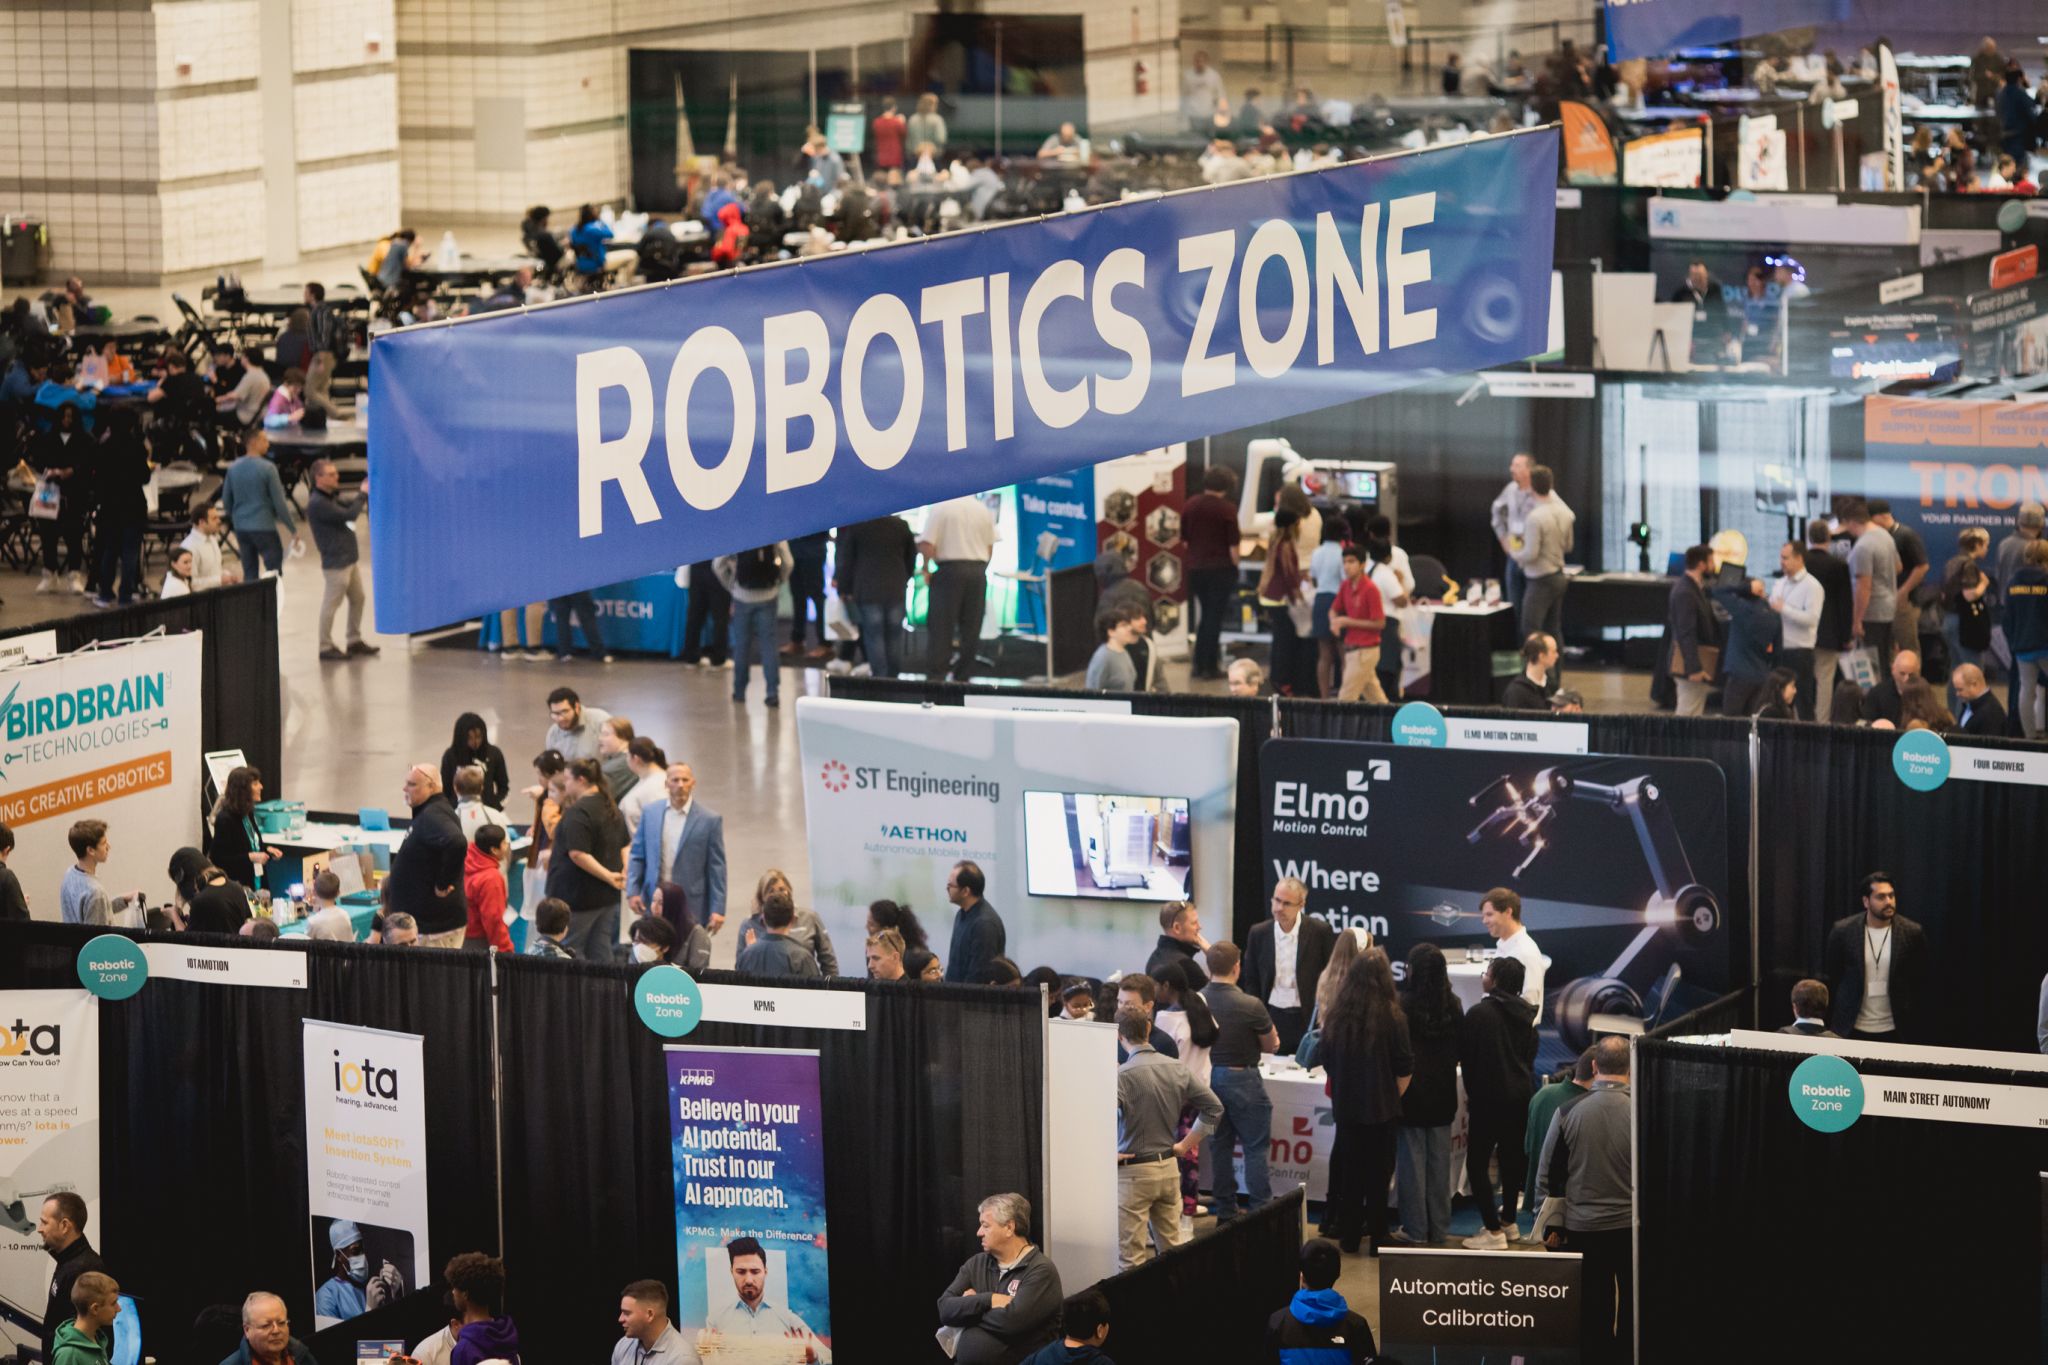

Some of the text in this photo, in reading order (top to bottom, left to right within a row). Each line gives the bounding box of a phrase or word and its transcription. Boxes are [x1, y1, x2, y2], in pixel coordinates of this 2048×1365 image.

[576, 191, 1437, 538] ROBOTICS ZONE
[1921, 512, 2016, 525] YOUR PARTNER IN
[7, 672, 164, 741] BIRDBRAIN
[1401, 724, 1438, 736] Robotic
[1464, 729, 1538, 743] ELMO MOTION CONTROL
[23, 718, 150, 764] TECHNOLOGIES
[1408, 736, 1431, 746] Zone
[1902, 752, 1941, 765] Robotic
[1973, 759, 2025, 773] FOUR GROWERS
[1909, 764, 1934, 776] Zone
[30, 781, 94, 814] CREATIVE
[98, 761, 165, 796] ROBOTICS
[855, 767, 1000, 803] ST Engineering
[1273, 781, 1369, 821] Elmo
[889, 825, 967, 843] AETHON
[1273, 820, 1367, 837] Motion Control
[864, 842, 999, 861] Autonomous Mobile Robots
[1273, 859, 1380, 892] Where
[1303, 906, 1389, 937] otion
[89, 958, 135, 971] Robotic
[187, 957, 229, 972] IOTAMOTION
[99, 972, 128, 983] Zone
[646, 992, 690, 1006] Robotic
[753, 1000, 775, 1013] KPMG
[655, 1006, 683, 1018] Zone
[12, 1059, 28, 1067] Can
[30, 1059, 44, 1067] You
[45, 1059, 61, 1067] Go?
[333, 1049, 398, 1100] iota
[680, 1074, 714, 1086] KPMG
[30, 1092, 50, 1102] that
[53, 1094, 60, 1102] a
[1802, 1084, 1850, 1098] Robotic
[336, 1096, 398, 1113] hearing, advanced.
[1811, 1099, 1843, 1111] Zone
[1883, 1090, 1991, 1110] MAIN STREET AUTONOMY
[20, 1106, 31, 1116] at
[44, 1106, 78, 1118] speed
[680, 1098, 800, 1125] Believe in your
[324, 1127, 350, 1142] Meet
[682, 1126, 782, 1151] AI potential.
[324, 1144, 412, 1168] Insertion System
[683, 1154, 775, 1179] Trust in our
[326, 1181, 355, 1192] designed
[685, 1183, 788, 1209] AI approach.
[685, 1226, 816, 1242] KPMG. Make the Difference.
[9, 1243, 19, 1251] 1.0
[1390, 1278, 1569, 1299] Automatic Sensor
[1423, 1309, 1535, 1328] Calibration
